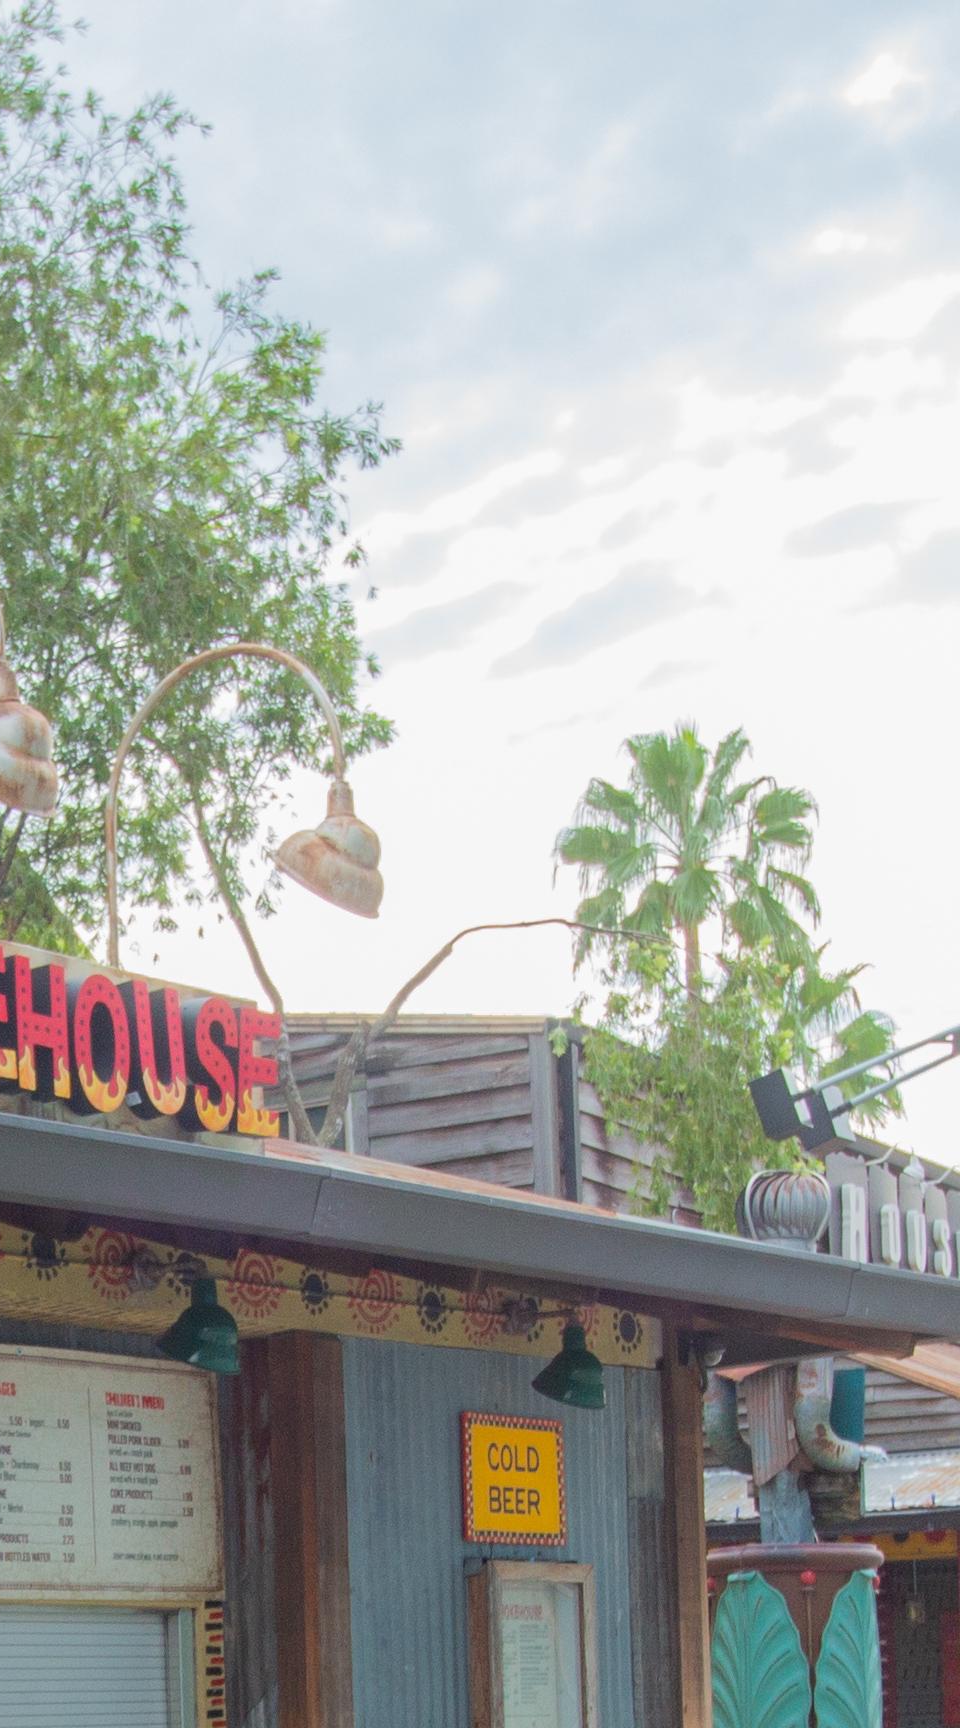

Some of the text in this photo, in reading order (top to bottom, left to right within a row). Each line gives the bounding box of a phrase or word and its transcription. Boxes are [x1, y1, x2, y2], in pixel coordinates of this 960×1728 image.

[108, 1434, 126, 1444] PULLED
[128, 1435, 141, 1445] PORK
[488, 1443, 540, 1472] COLD
[125, 1489, 152, 1500] PRODUCTS
[489, 1486, 540, 1516] BEER
[4, 1551, 30, 1562] BOTTLED
[32, 1552, 50, 1563] WATER
